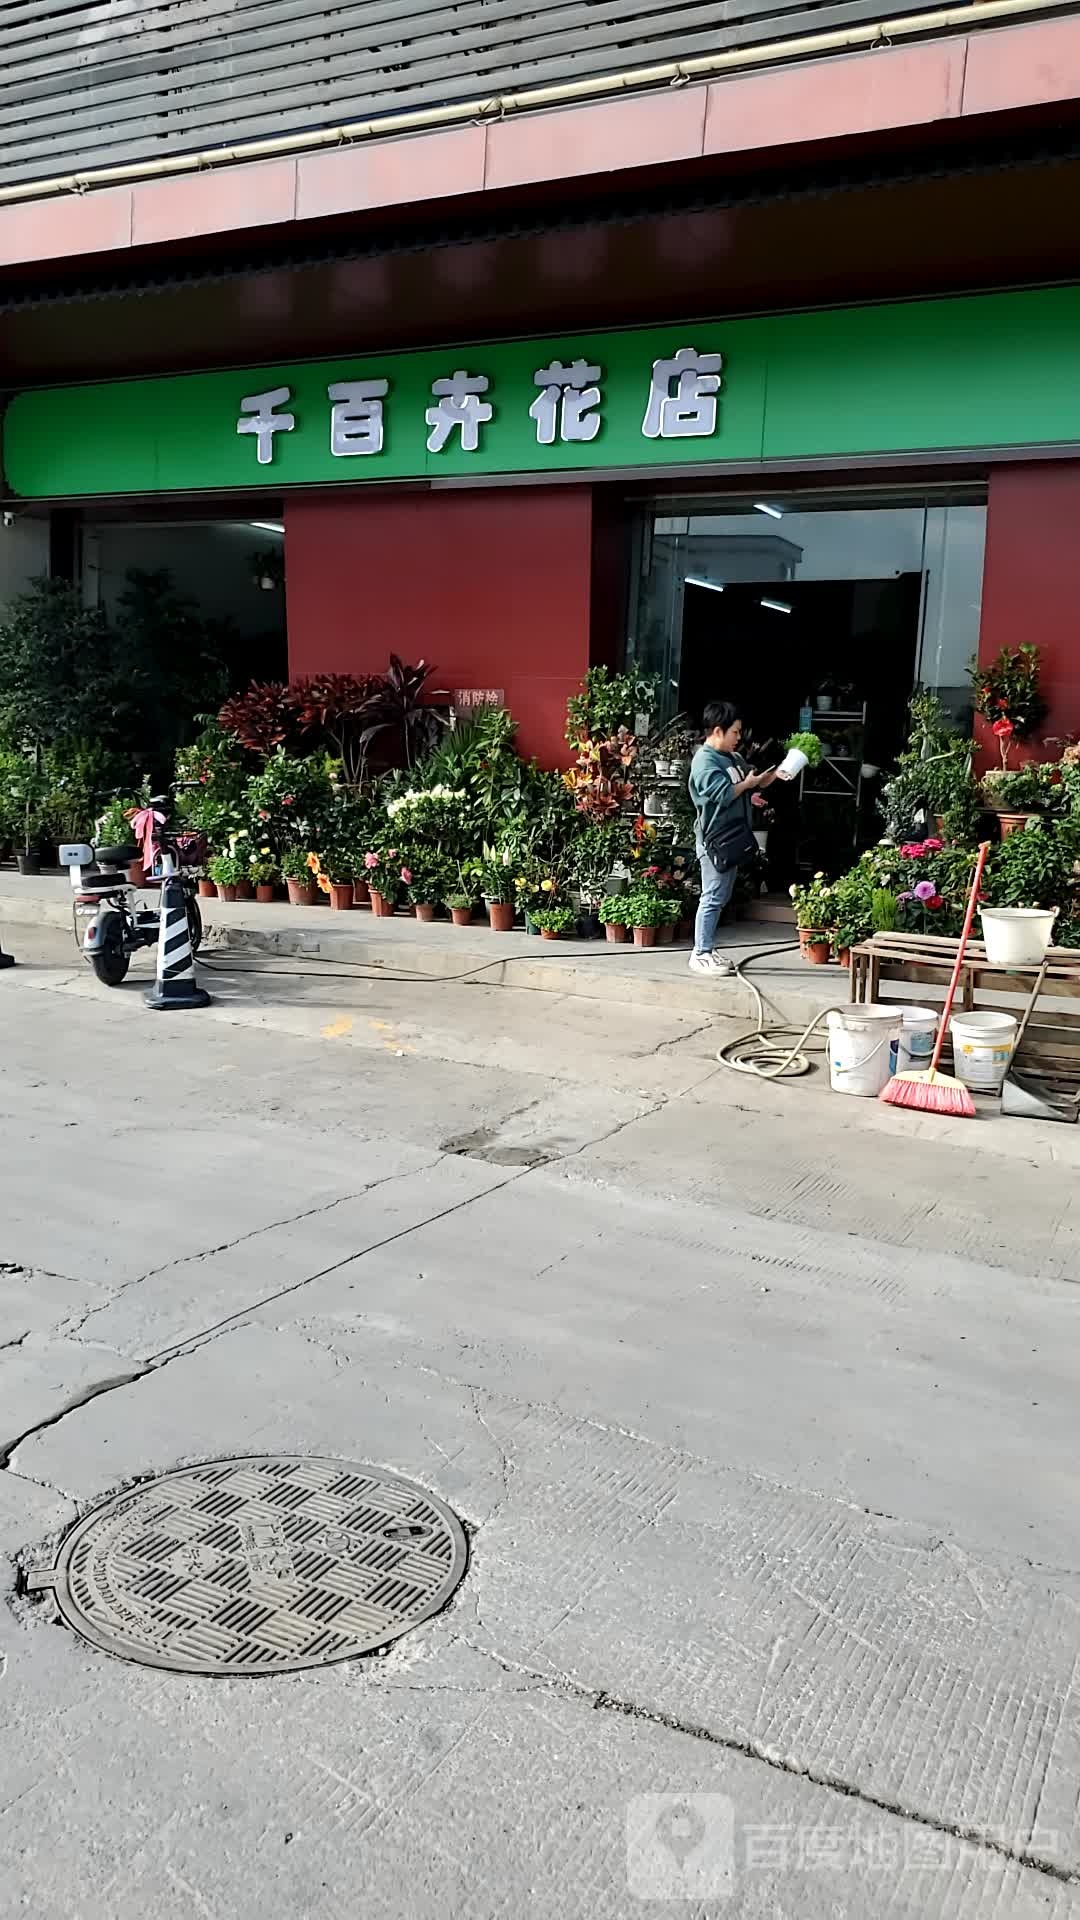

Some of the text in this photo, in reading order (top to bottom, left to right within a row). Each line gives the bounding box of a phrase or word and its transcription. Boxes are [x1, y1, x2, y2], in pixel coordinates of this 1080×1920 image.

[237, 347, 722, 464] 千百卉花店
